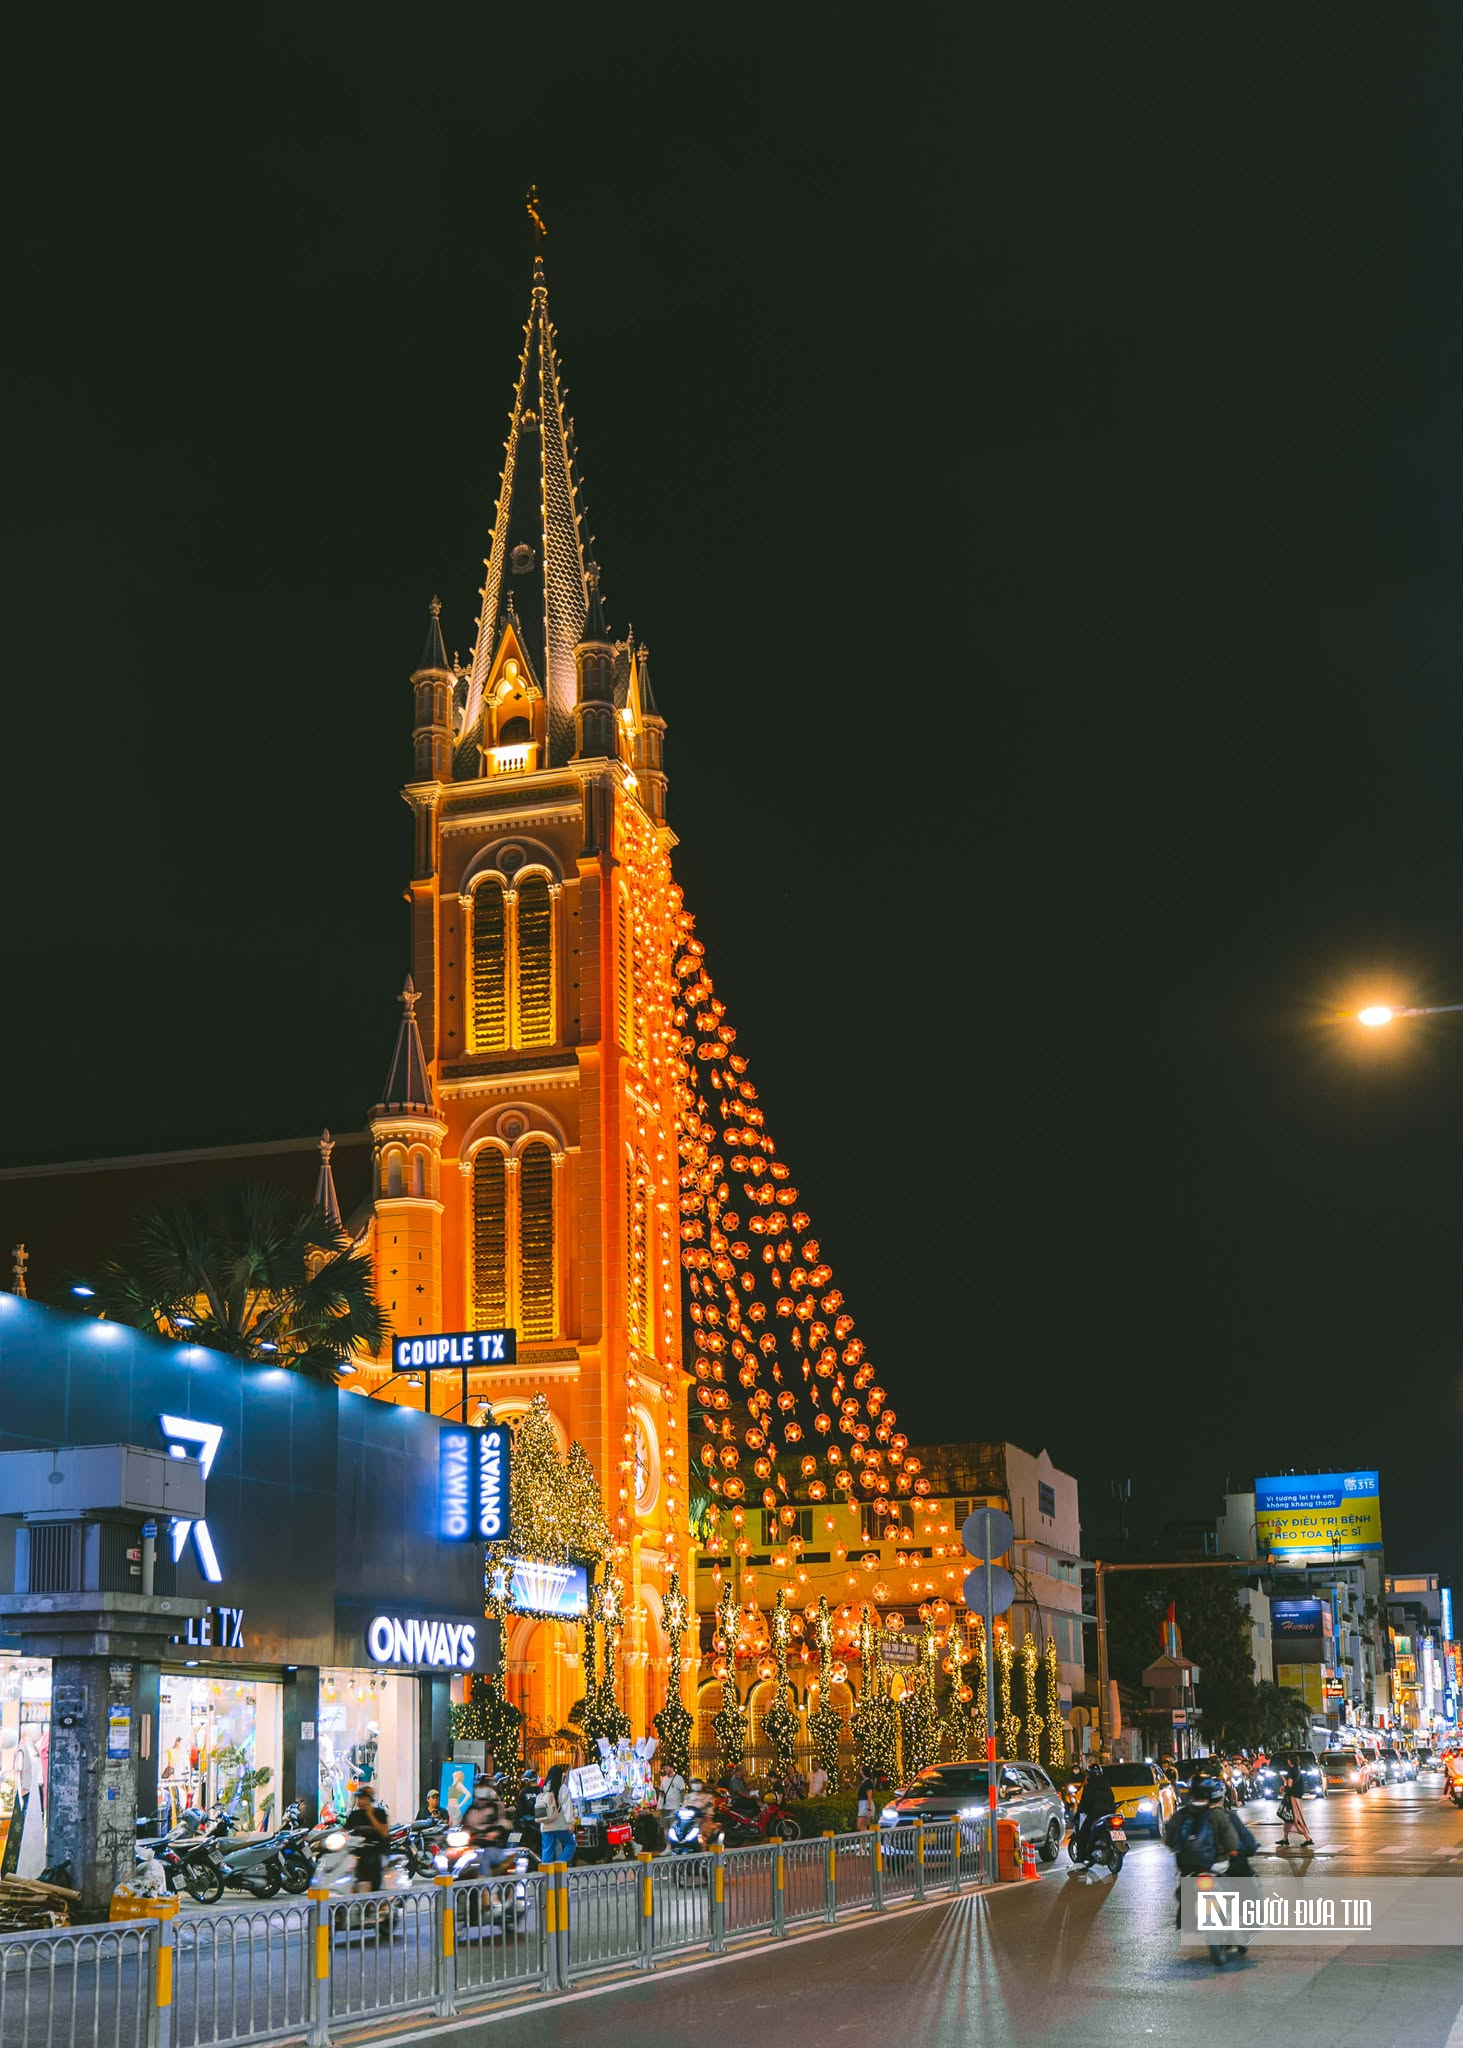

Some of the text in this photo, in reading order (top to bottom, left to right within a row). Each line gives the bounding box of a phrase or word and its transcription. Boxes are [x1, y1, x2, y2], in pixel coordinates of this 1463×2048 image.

[398, 1334, 504, 1366] COUPLE TX
[480, 1432, 500, 1536] ONWAYS
[1357, 1481, 1375, 1490] 315
[1268, 1532, 1297, 1540] THEO
[1326, 1528, 1348, 1537] BÁC
[1292, 1515, 1317, 1526] ĐIỀU
[1341, 1514, 1371, 1524] BỆNH
[219, 1607, 244, 1647] TX
[368, 1615, 476, 1668] ONWAYS
